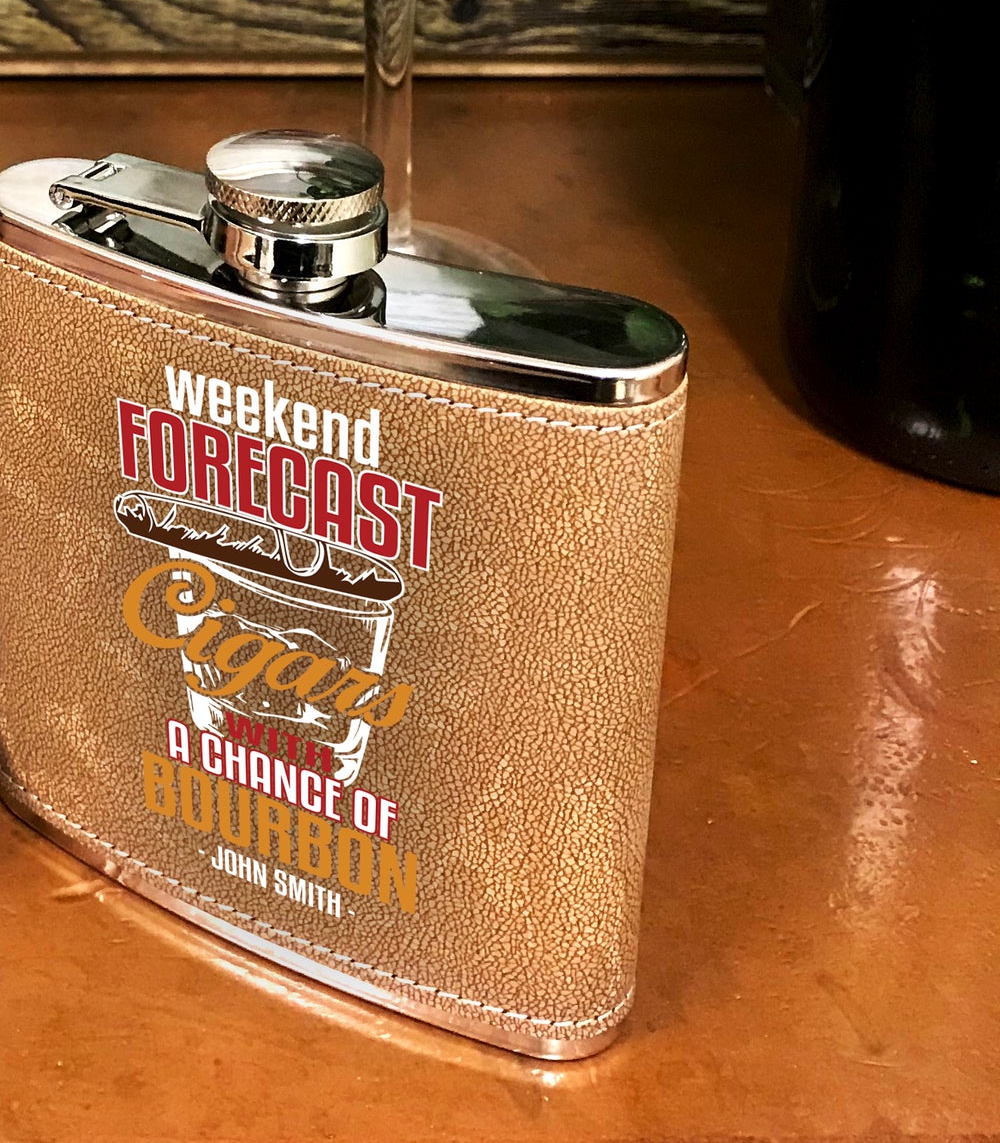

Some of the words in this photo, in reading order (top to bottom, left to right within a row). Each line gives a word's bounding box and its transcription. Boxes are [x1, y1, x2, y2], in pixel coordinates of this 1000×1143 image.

[165, 365, 380, 468] weekend
[116, 398, 443, 570] FORECAST
[123, 562, 415, 727] Cigars
[166, 718, 192, 765] A
[200, 730, 343, 822] CHANCE
[352, 787, 398, 841] OF
[225, 711, 332, 773] WITH
[142, 750, 418, 915] BOURBON
[211, 845, 267, 889] JOHN
[274, 868, 341, 918] SMITH
